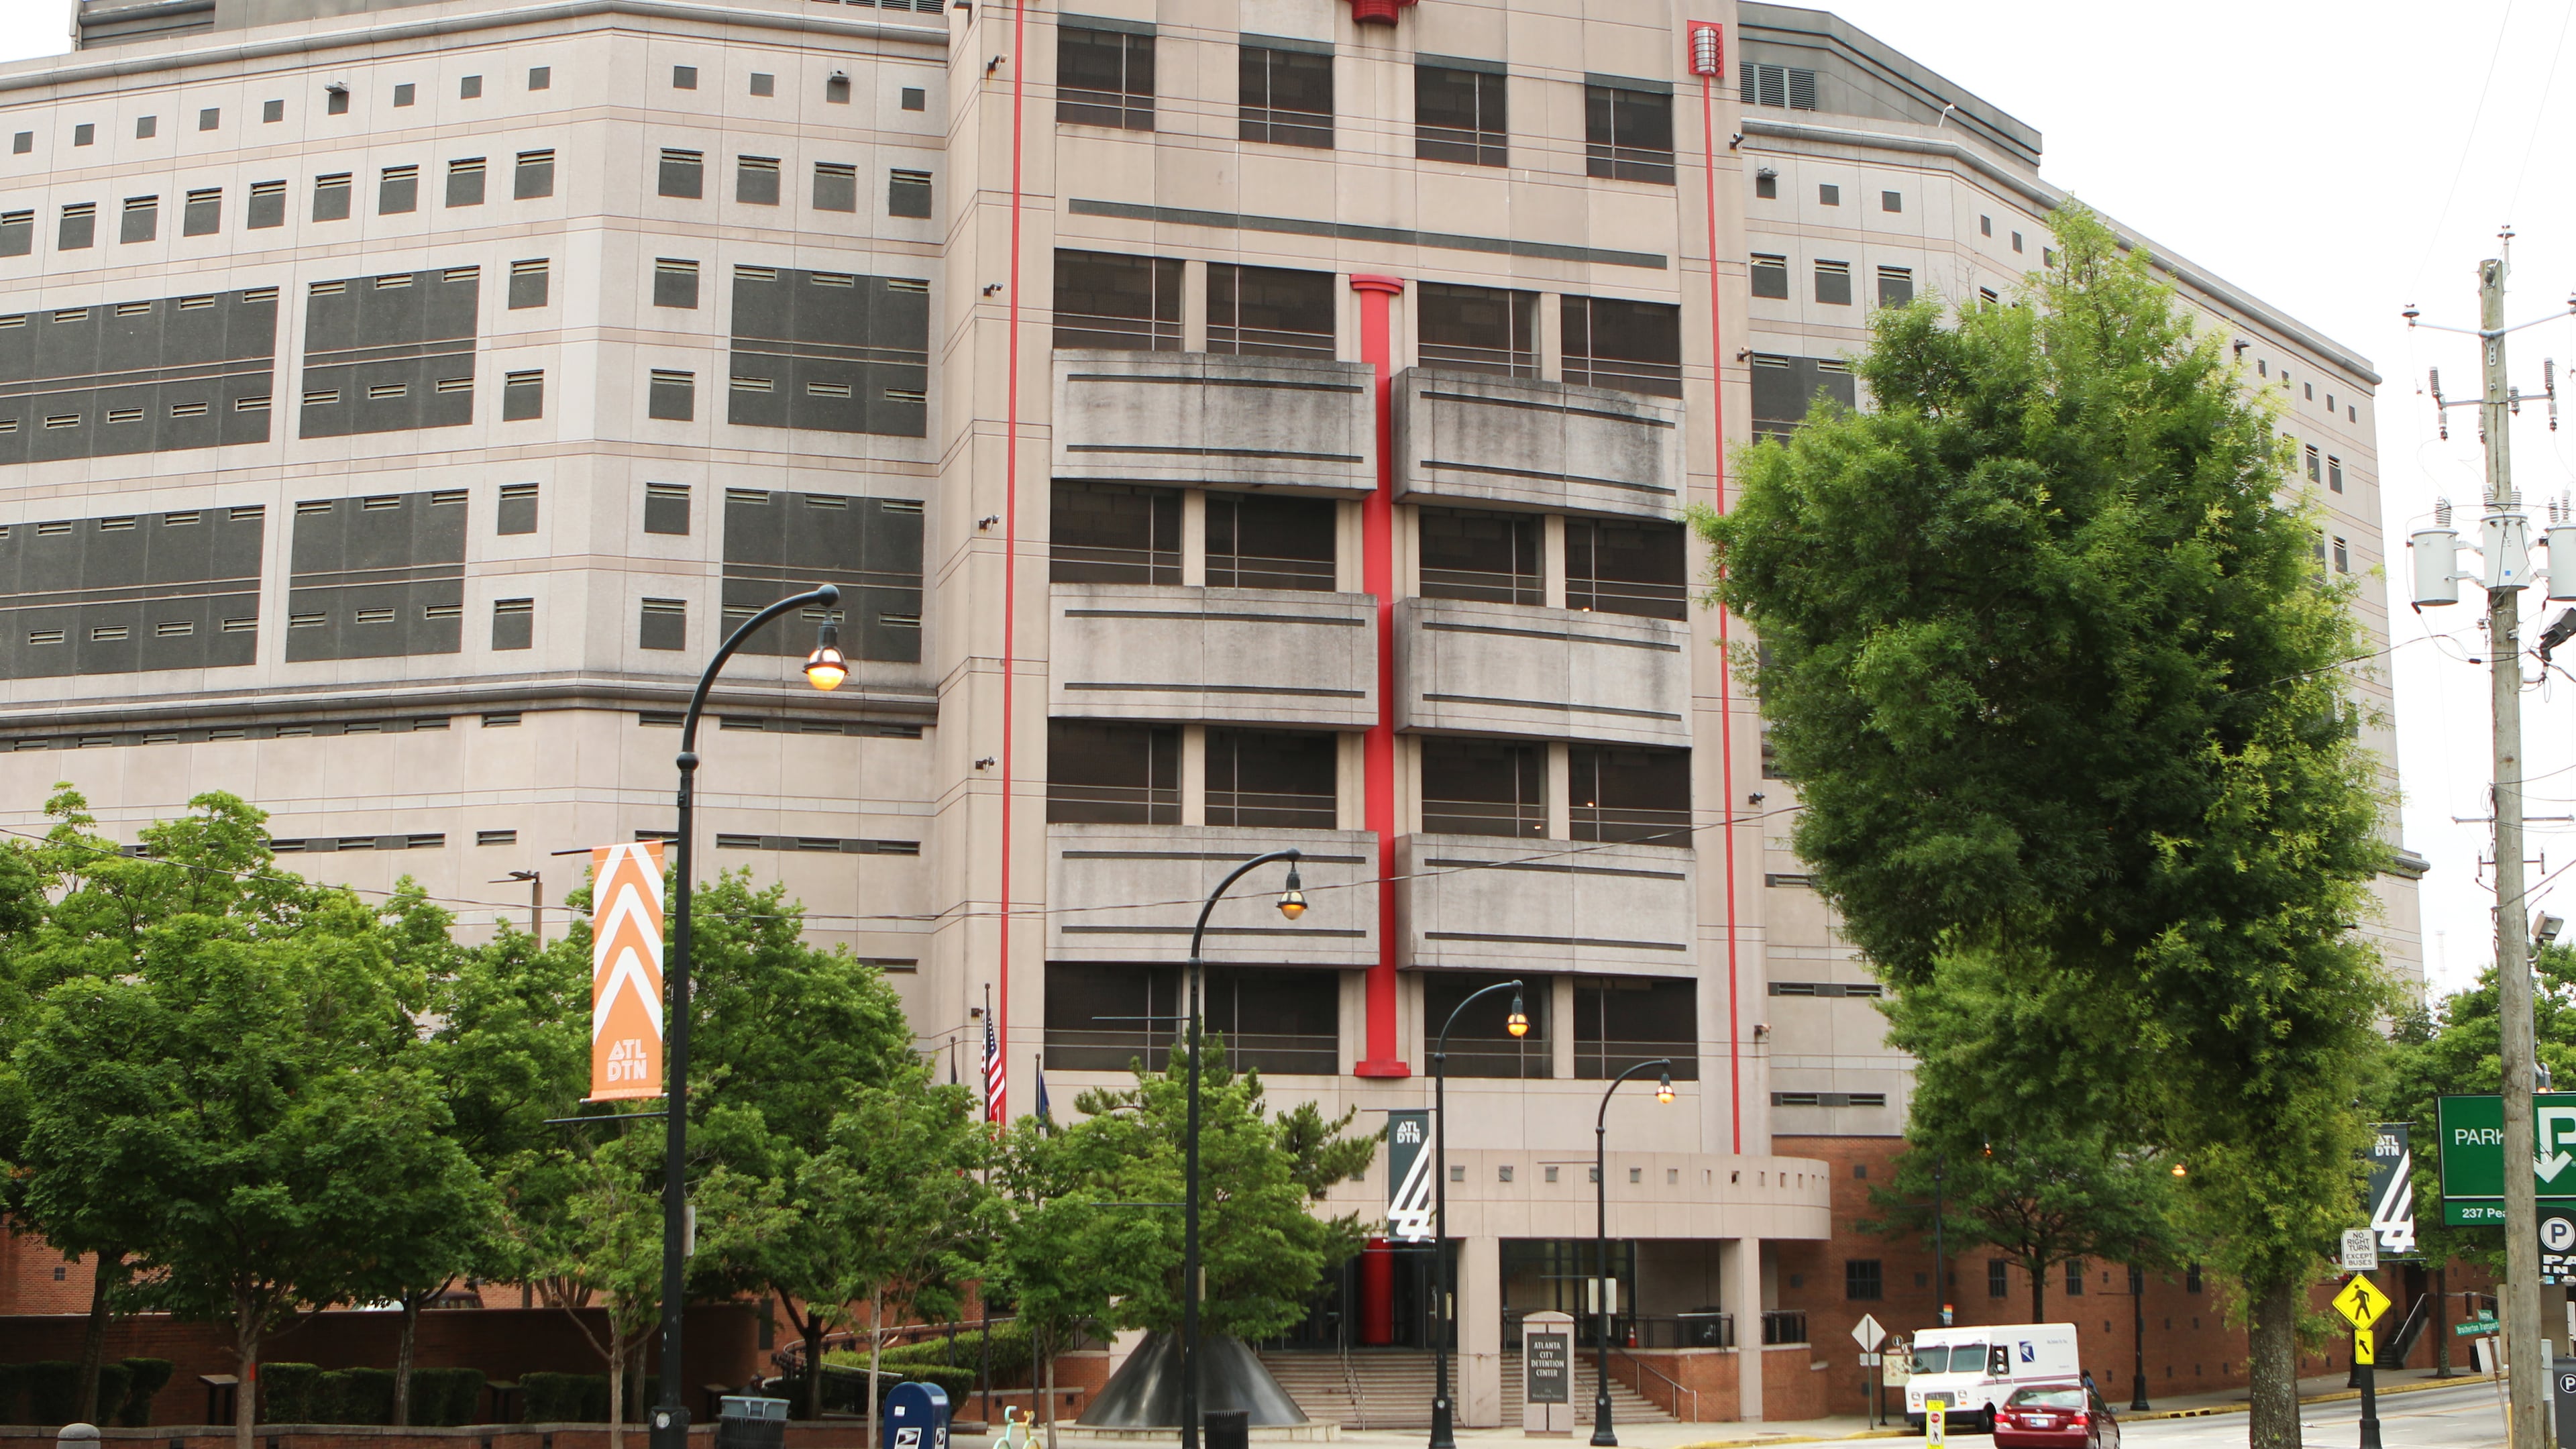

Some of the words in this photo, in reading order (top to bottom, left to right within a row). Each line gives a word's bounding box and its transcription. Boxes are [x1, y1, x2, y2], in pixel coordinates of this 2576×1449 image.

[608, 1038, 647, 1061] ATL
[607, 1059, 647, 1082] DTN
[1397, 1121, 1420, 1132] ATL
[1397, 1132, 1421, 1144] DTN
[2375, 1145, 2400, 1157] DTN
[2461, 1208, 2483, 1218] 237
[2551, 1223, 2567, 1244] P
[2542, 1265, 2569, 1275] IN
[1534, 1342, 1561, 1350] ATLANTA
[1539, 1351, 1554, 1359] CITY
[1531, 1359, 1564, 1368] DETENTION
[1536, 1368, 1558, 1377] CENTER
